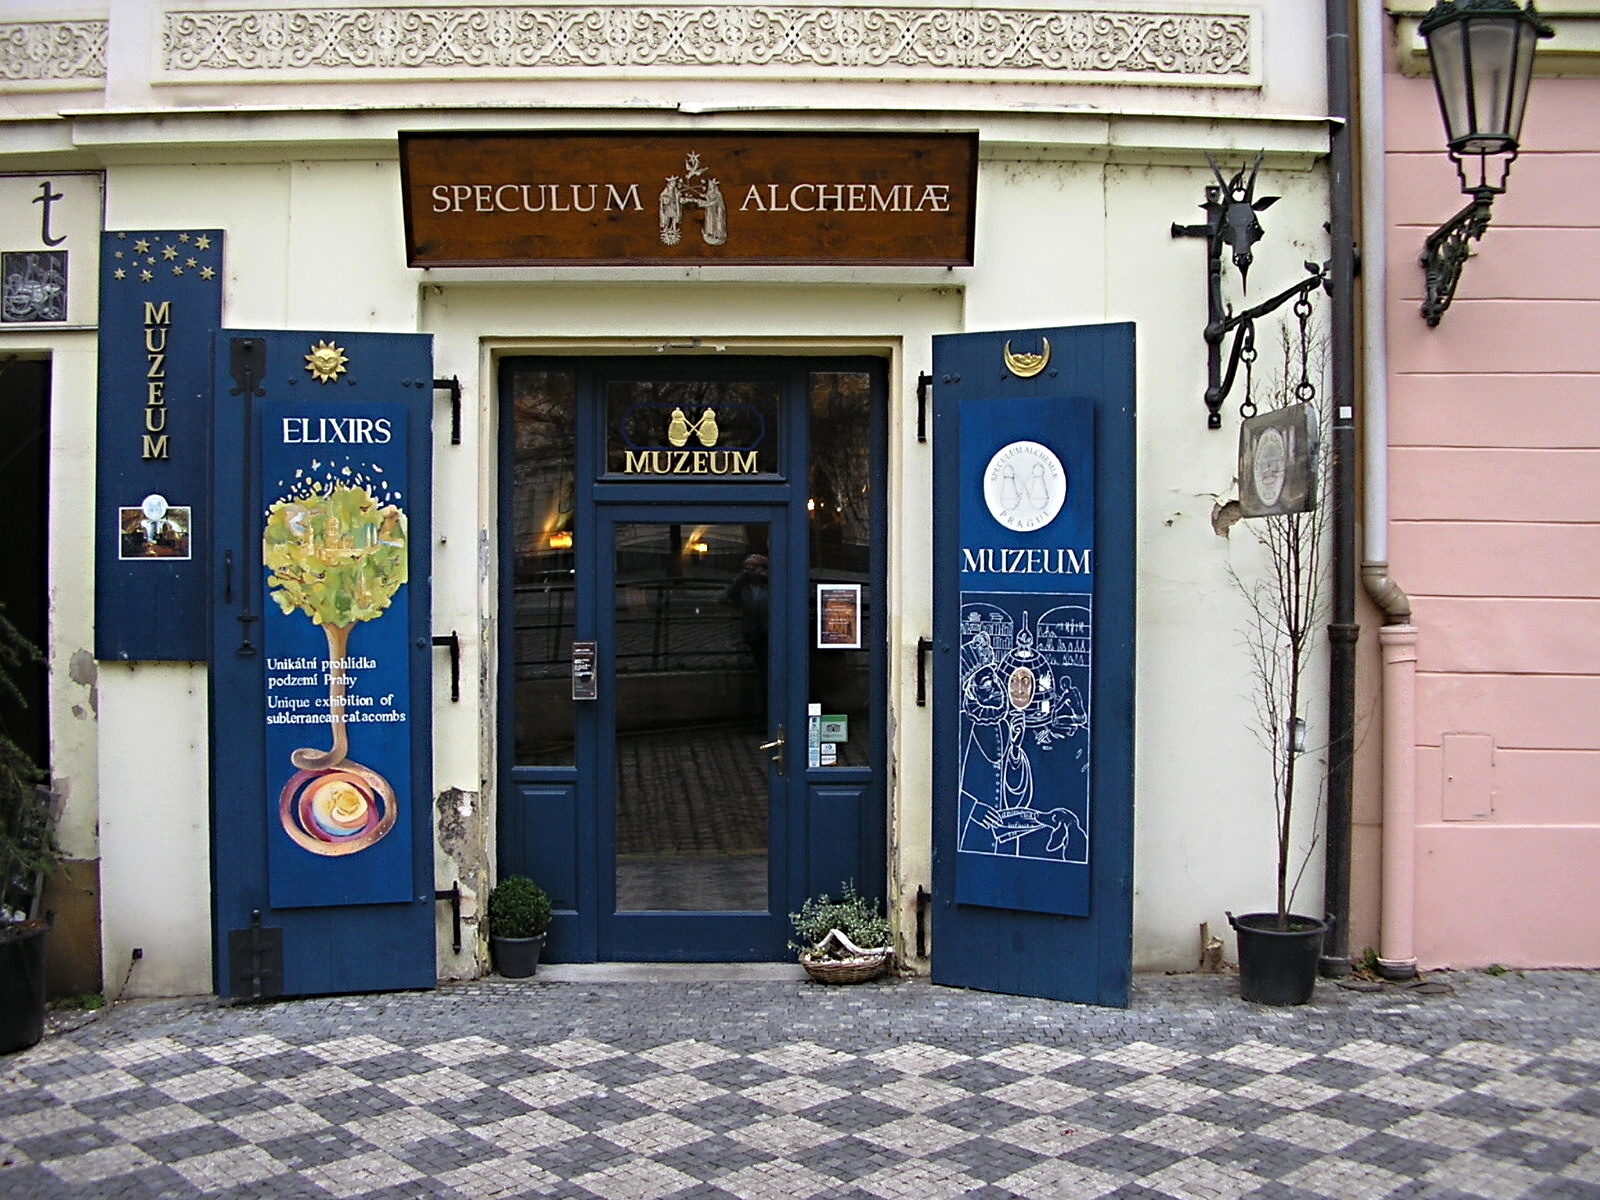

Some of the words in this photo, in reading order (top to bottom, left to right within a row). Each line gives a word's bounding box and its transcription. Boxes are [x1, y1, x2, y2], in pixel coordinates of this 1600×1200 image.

[432, 183, 644, 214] SPECULUM
[740, 183, 950, 213] ALCHEMIÆ
[141, 301, 172, 460] MUZEUM
[283, 417, 392, 444] ELIXIRS
[624, 450, 759, 475] MUZEUM
[999, 509, 1052, 529] PRAGUE
[961, 548, 1092, 575] MUZEUM
[266, 657, 318, 670] Unikátní
[321, 657, 377, 672] prohlídka
[268, 674, 318, 689] podzemí
[324, 674, 358, 688] Prahy
[267, 695, 310, 711] Unique
[315, 695, 374, 707] exhibition
[380, 694, 395, 706] of
[266, 711, 339, 724] subterranean
[341, 709, 406, 723] catacombs
